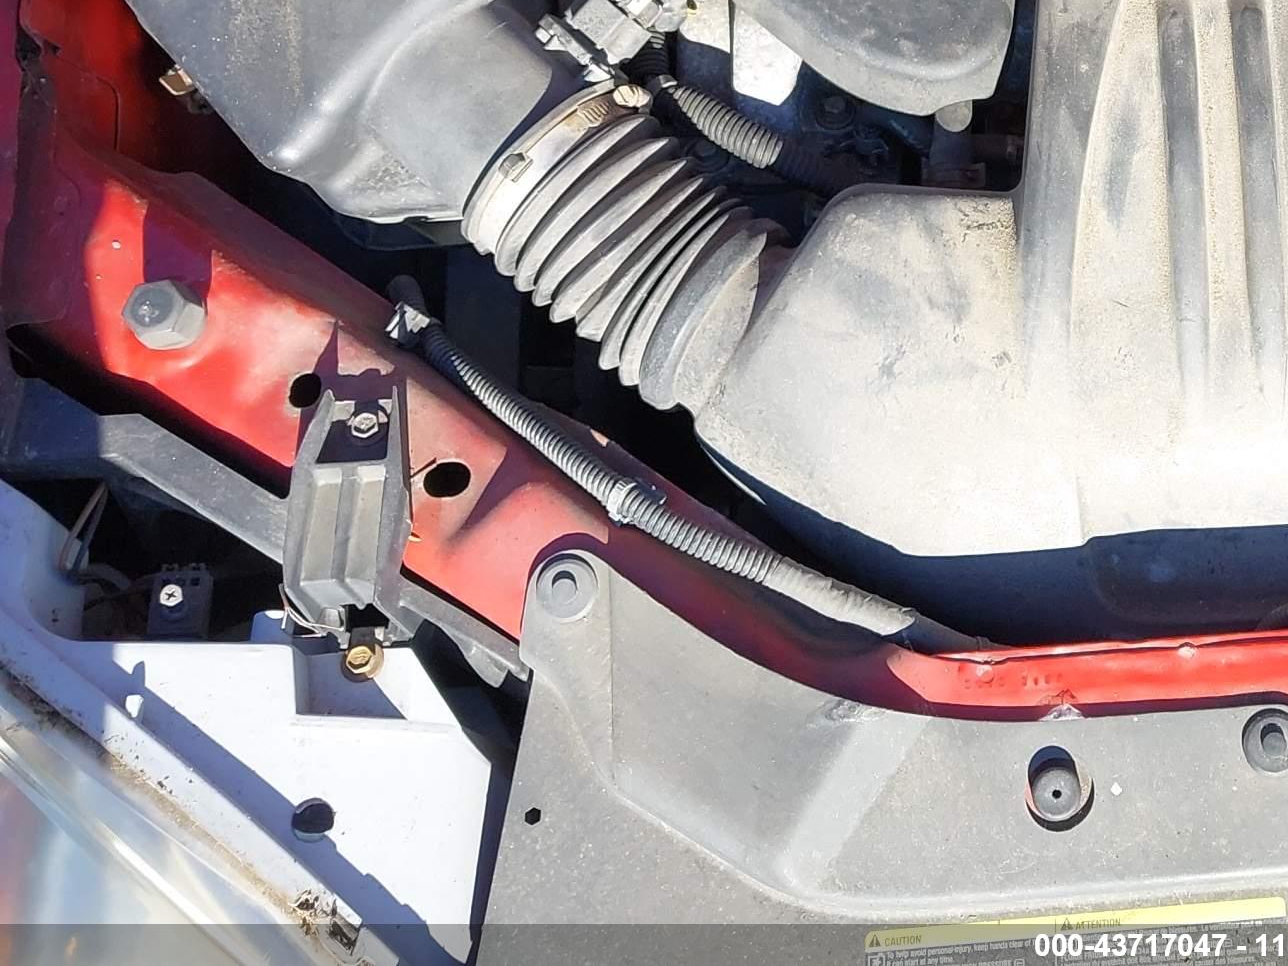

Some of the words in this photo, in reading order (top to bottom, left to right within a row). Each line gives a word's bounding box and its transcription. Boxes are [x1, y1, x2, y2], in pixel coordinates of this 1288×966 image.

[1075, 918, 1121, 930] ATTENTION
[884, 935, 922, 947] CAUTION
[928, 945, 954, 957] personal
